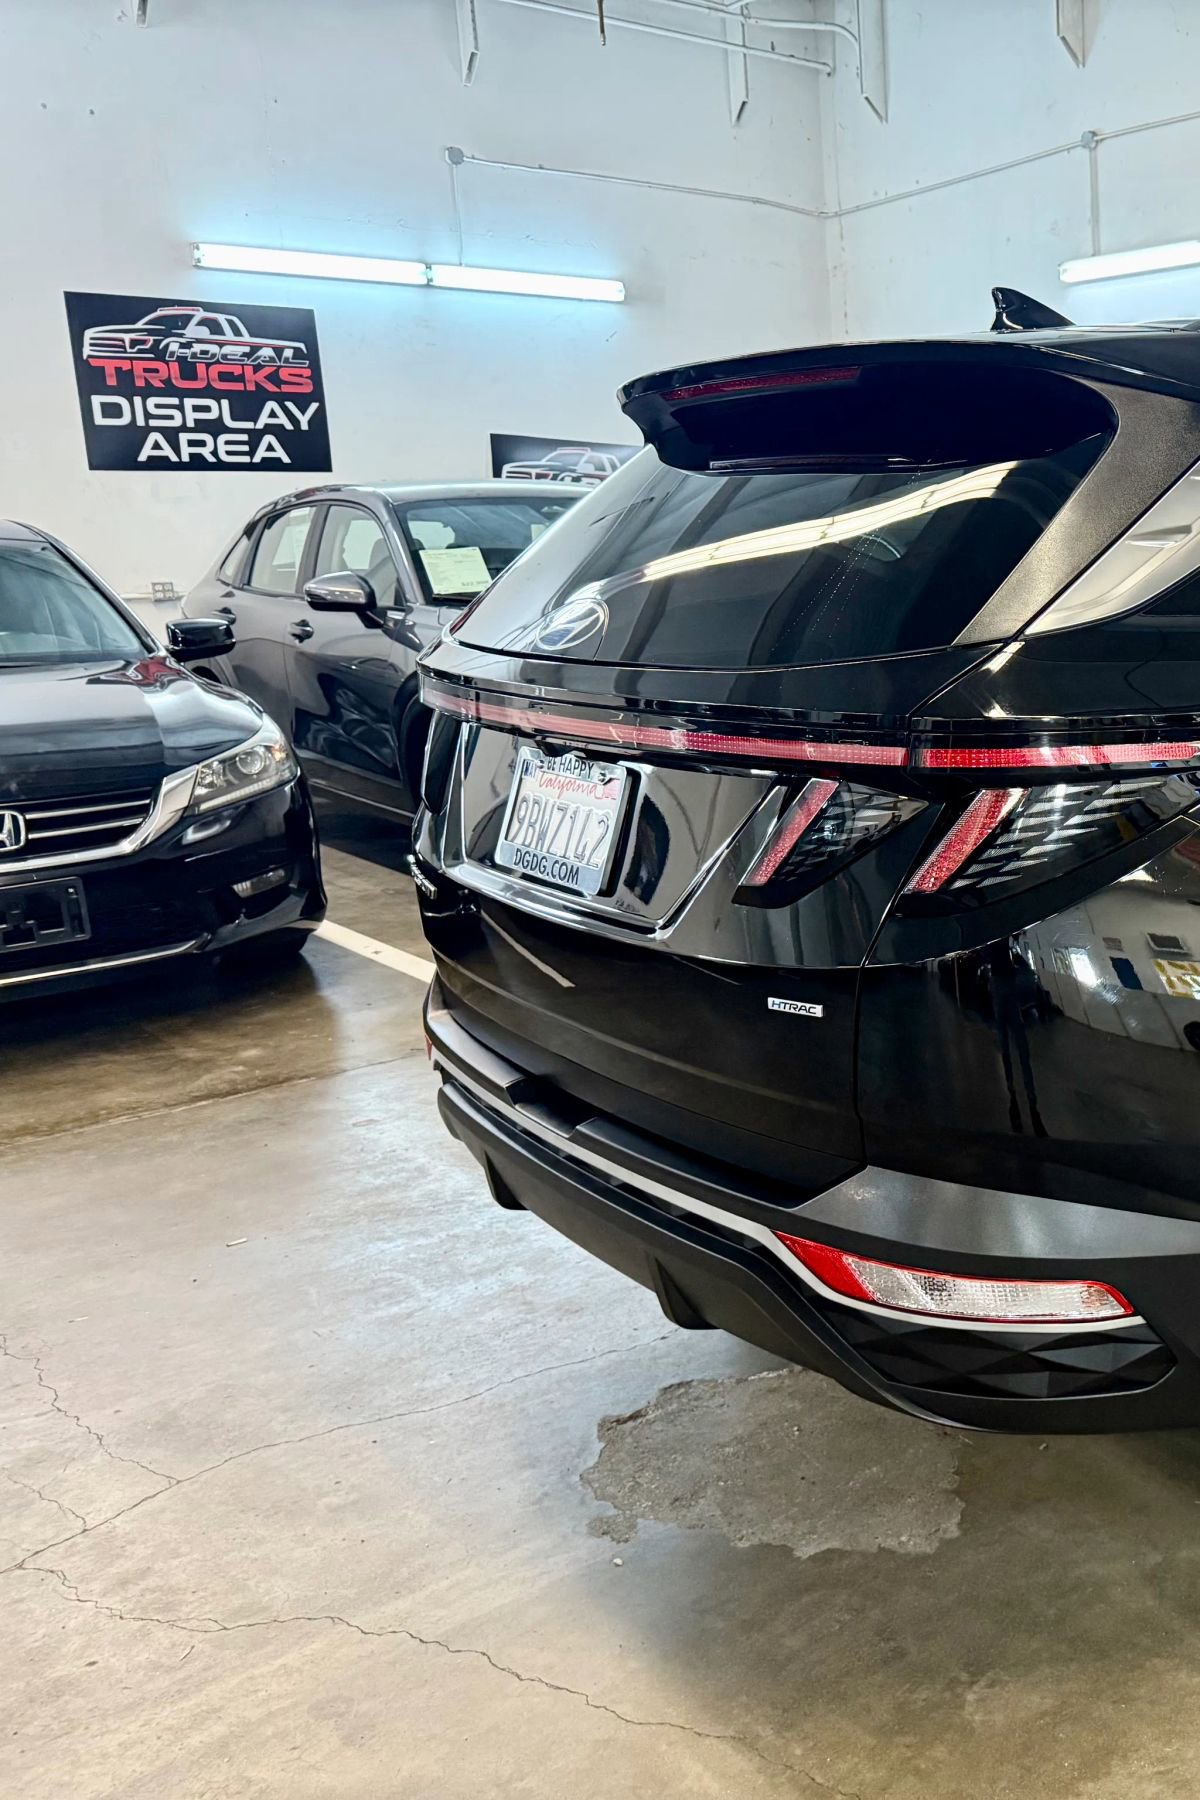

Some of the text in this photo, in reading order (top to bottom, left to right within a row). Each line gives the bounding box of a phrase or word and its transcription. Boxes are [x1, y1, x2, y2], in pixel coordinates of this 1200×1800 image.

[165, 341, 310, 367] I-DEAL
[87, 358, 313, 393] TRUCKS
[90, 395, 319, 430] DISPLAY
[137, 432, 292, 463] AREA
[560, 756, 595, 779] HAPPY
[513, 847, 580, 886] DGDG.COM
[771, 999, 817, 1015] HTRAC
